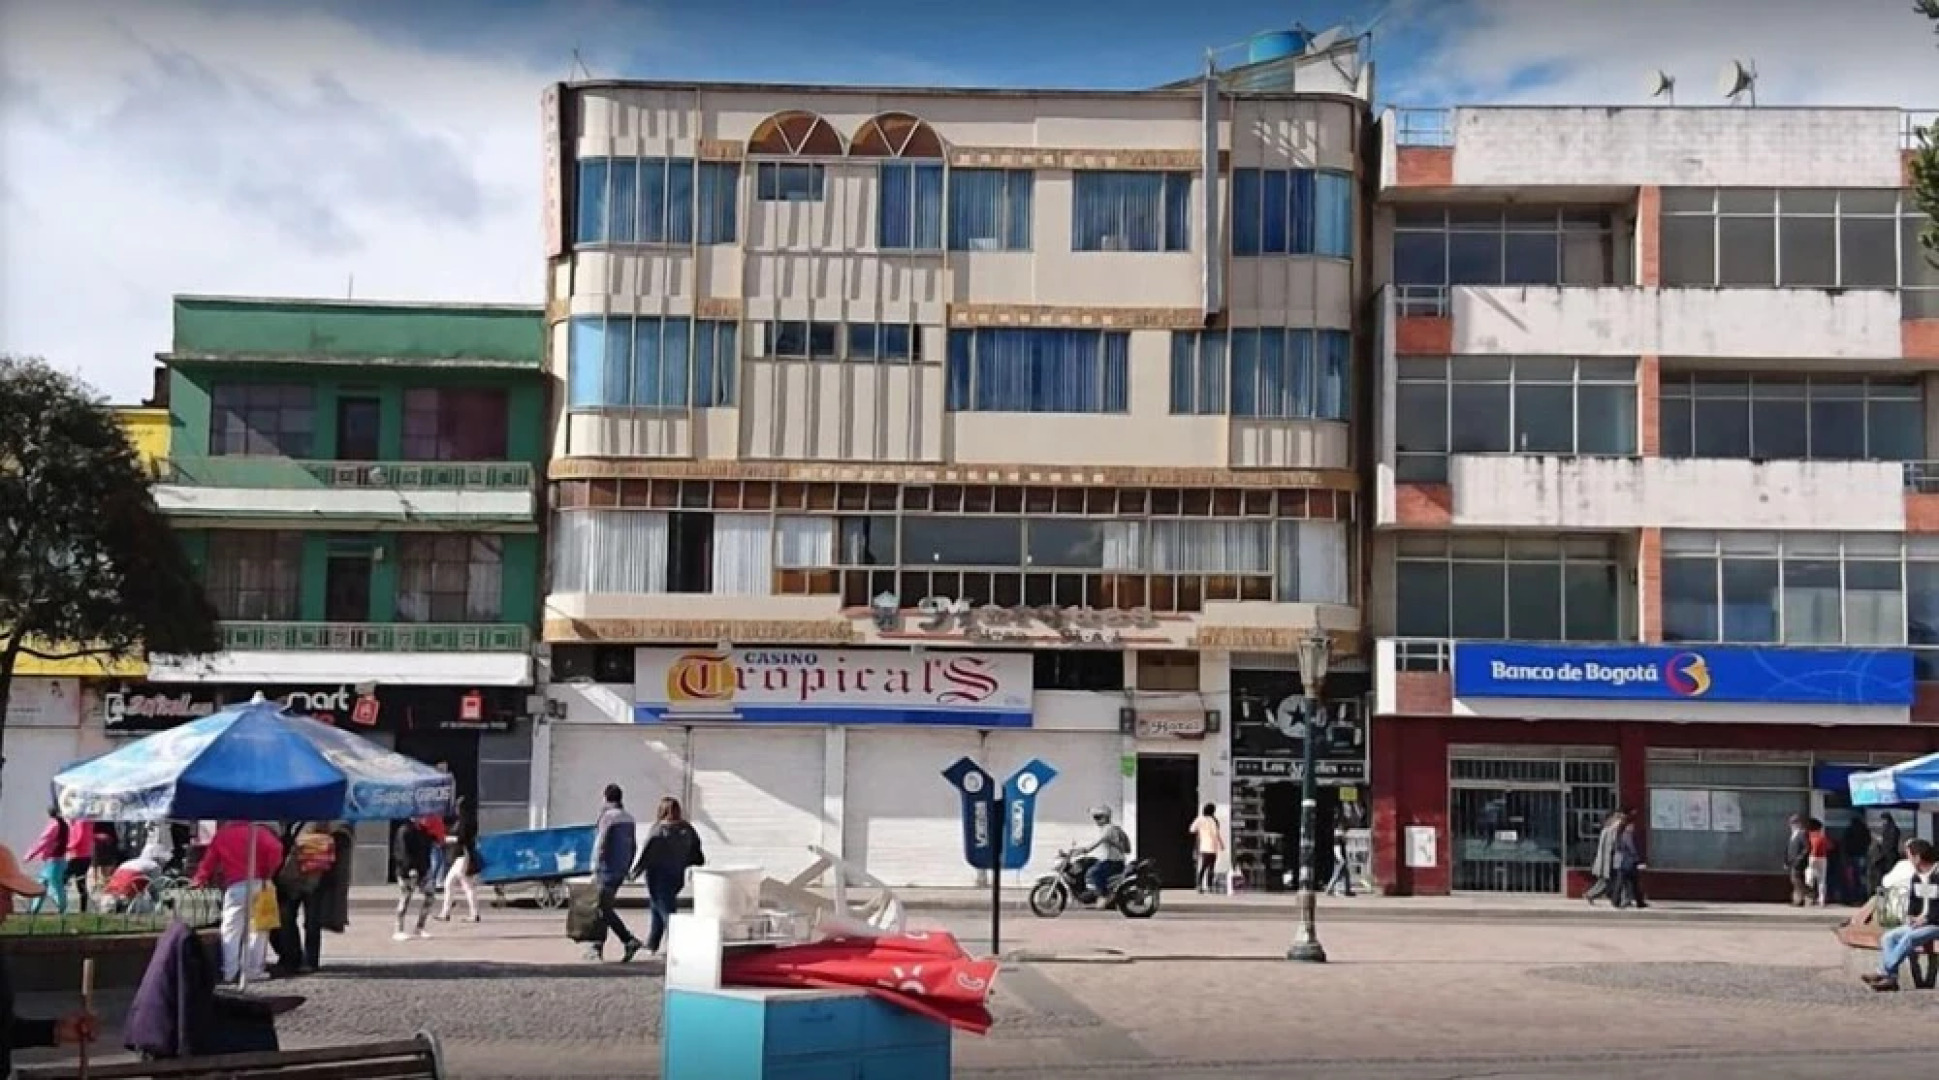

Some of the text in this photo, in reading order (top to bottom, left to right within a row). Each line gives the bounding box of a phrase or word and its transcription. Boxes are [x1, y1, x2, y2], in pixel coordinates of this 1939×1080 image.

[744, 652, 818, 666] CASINO
[1491, 660, 1659, 686] Banco de Bogotá
